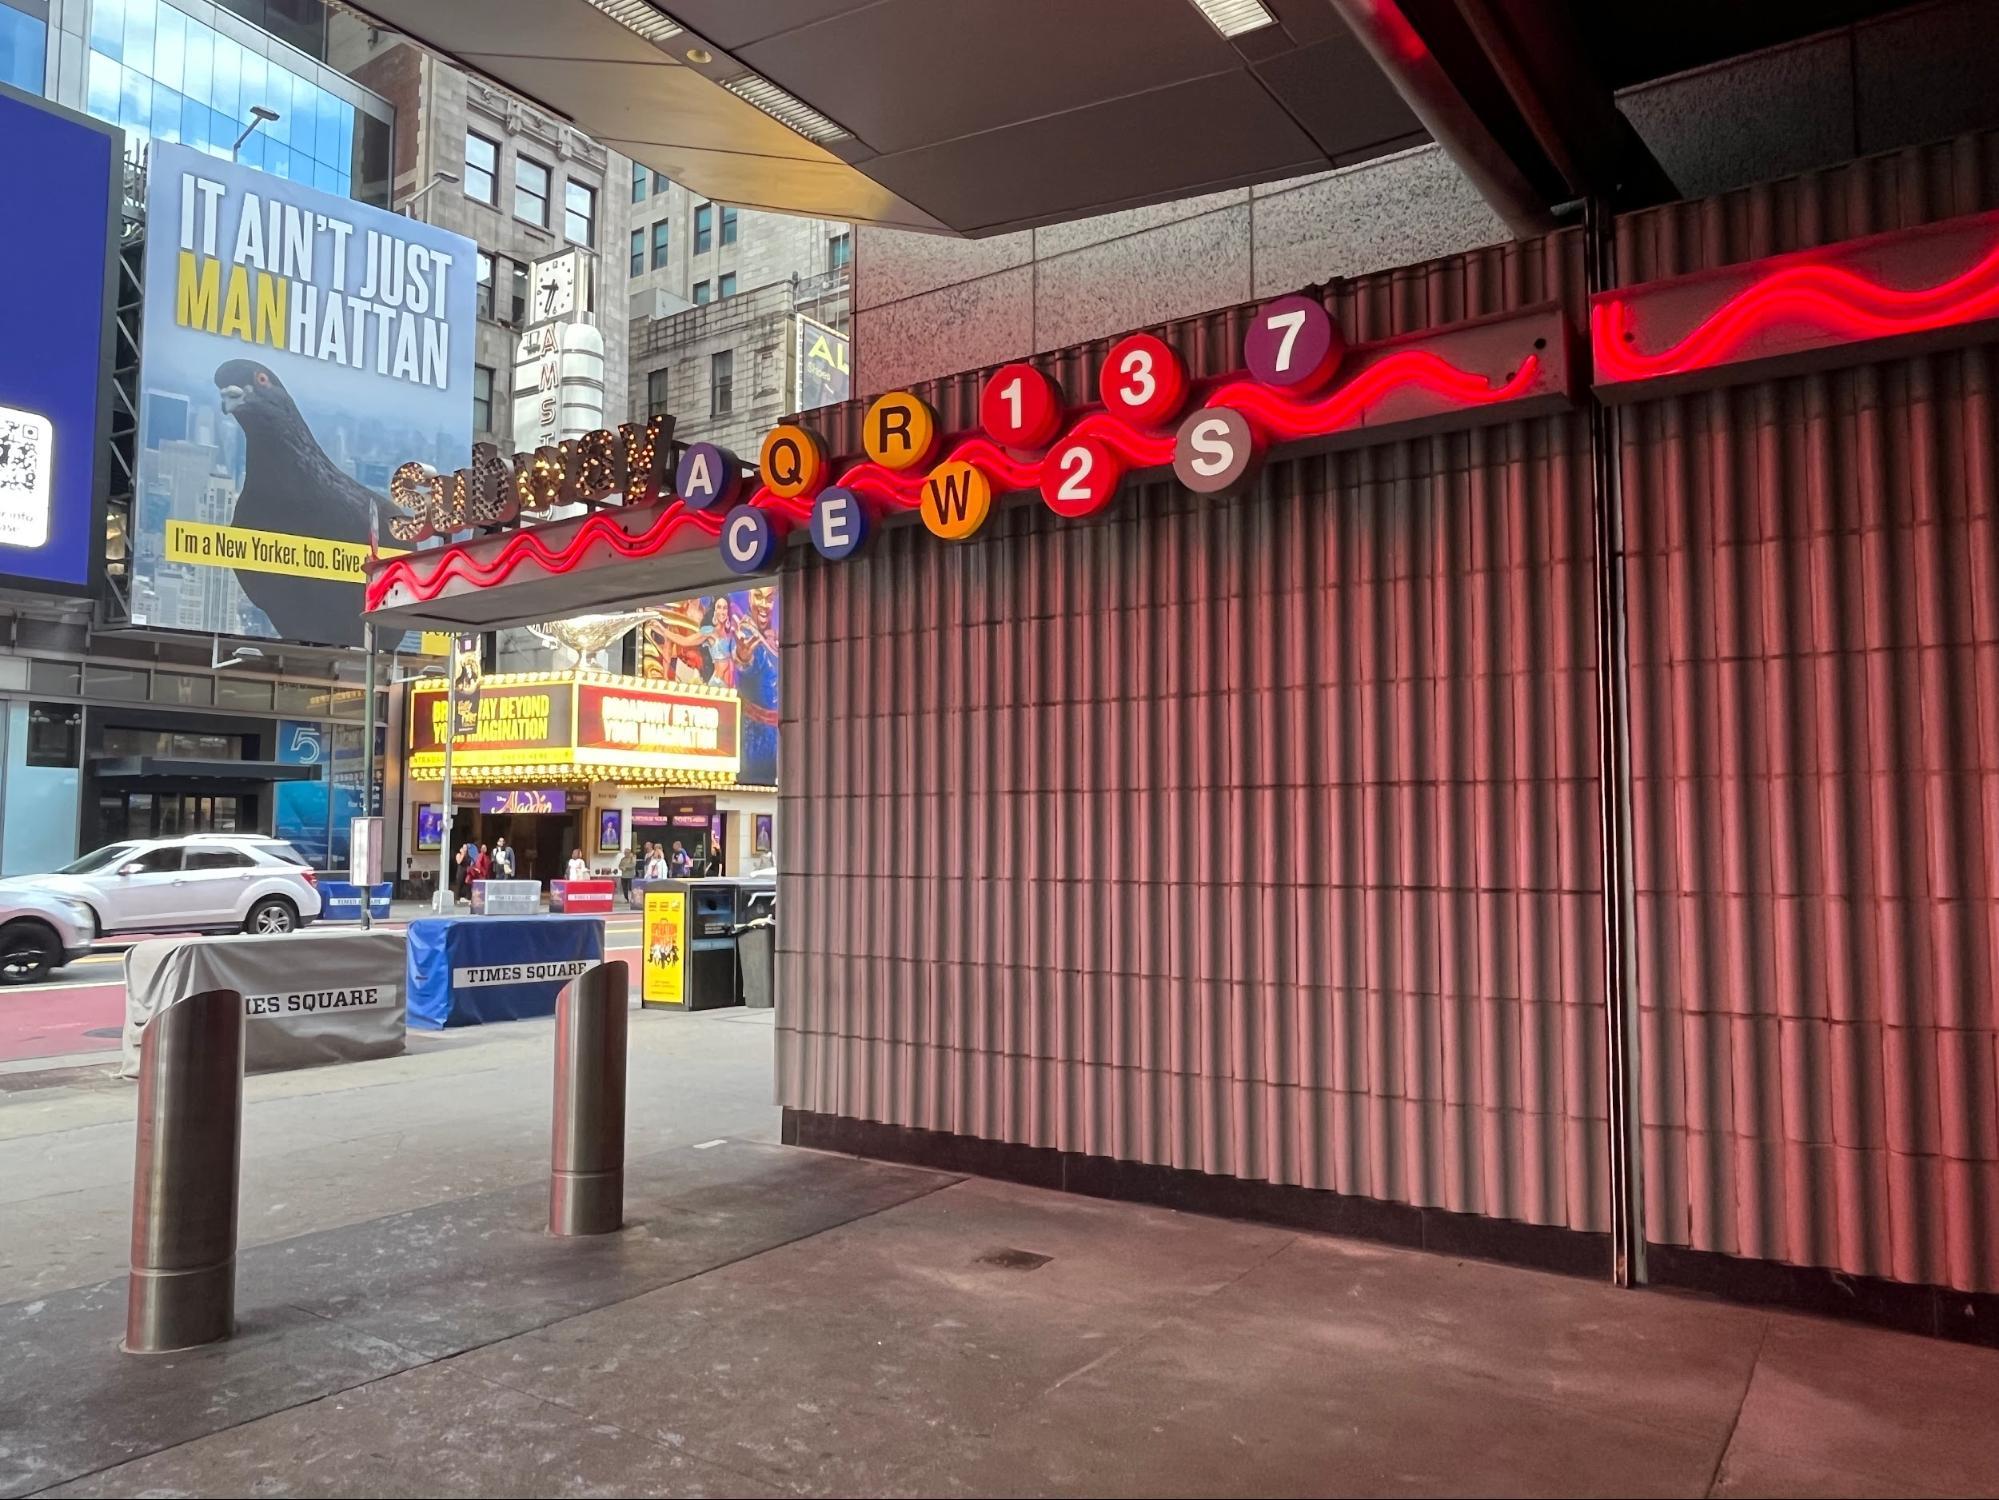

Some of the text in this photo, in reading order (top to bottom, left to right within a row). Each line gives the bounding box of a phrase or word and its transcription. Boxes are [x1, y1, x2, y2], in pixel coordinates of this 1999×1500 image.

[180, 173, 452, 319] IT AIN'T JUST
[176, 251, 449, 390] MANHATTAN
[685, 310, 1306, 498] A Q R 1 3 7
[728, 419, 1234, 562] C E W 2 S
[175, 527, 360, 573] I'm a New Yorker, too. Give
[500, 695, 549, 719] BEYOND
[290, 727, 320, 765] 5
[491, 790, 552, 813] Aladdin
[467, 967, 521, 982] TIMES
[288, 988, 378, 1011] SQUARE
